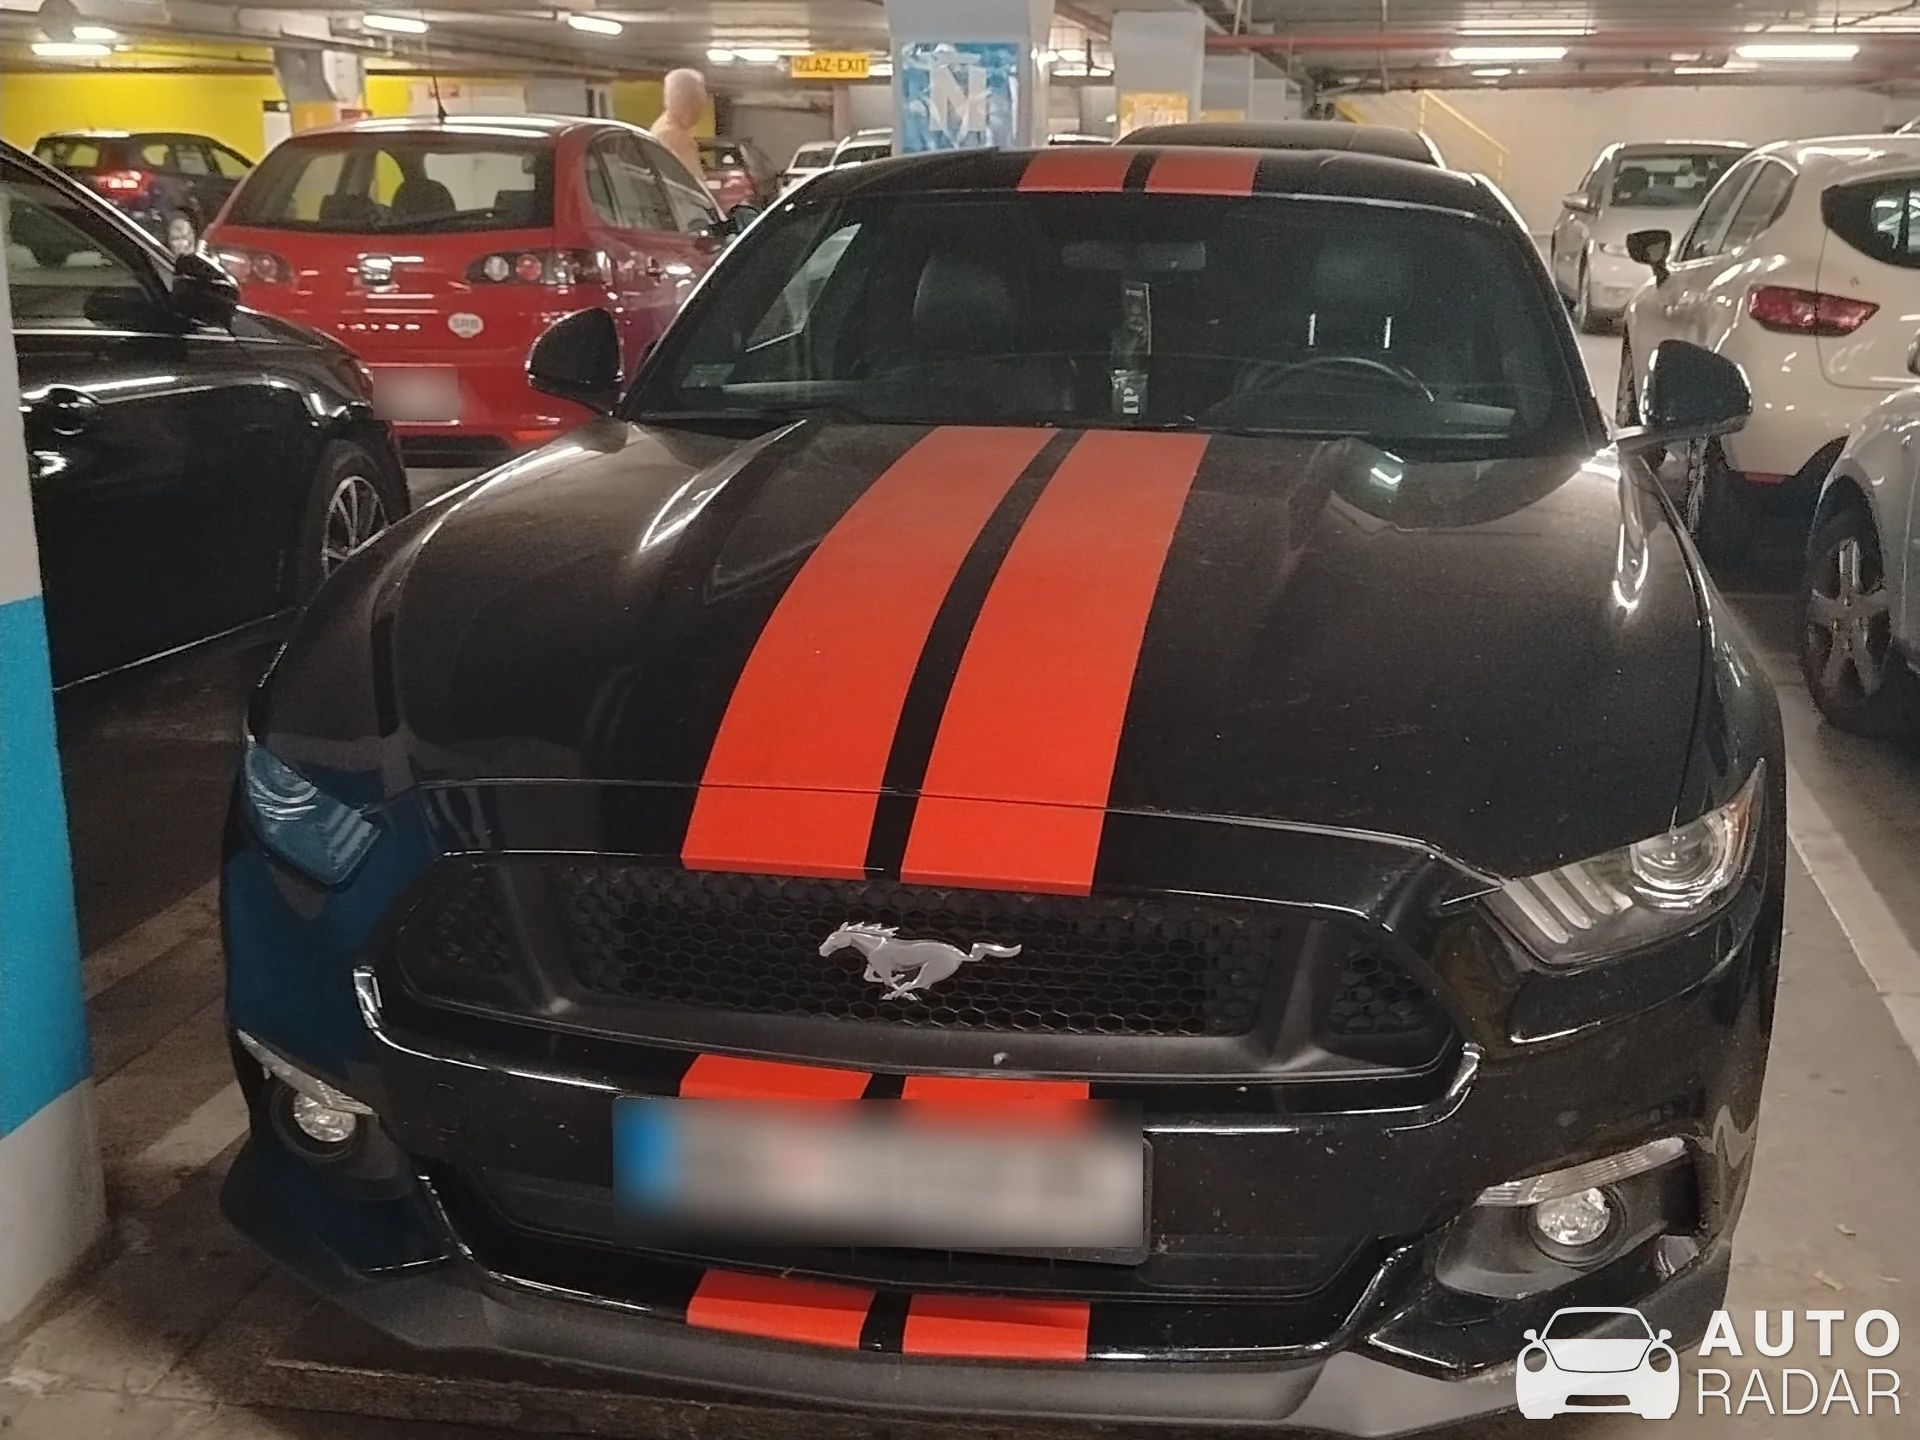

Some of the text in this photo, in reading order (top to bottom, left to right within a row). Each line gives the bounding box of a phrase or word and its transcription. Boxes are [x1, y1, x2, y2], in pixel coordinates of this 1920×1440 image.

[794, 57, 867, 73] IZLAZ-EXIT
[929, 63, 987, 131] N
[452, 318, 480, 330] SRB
